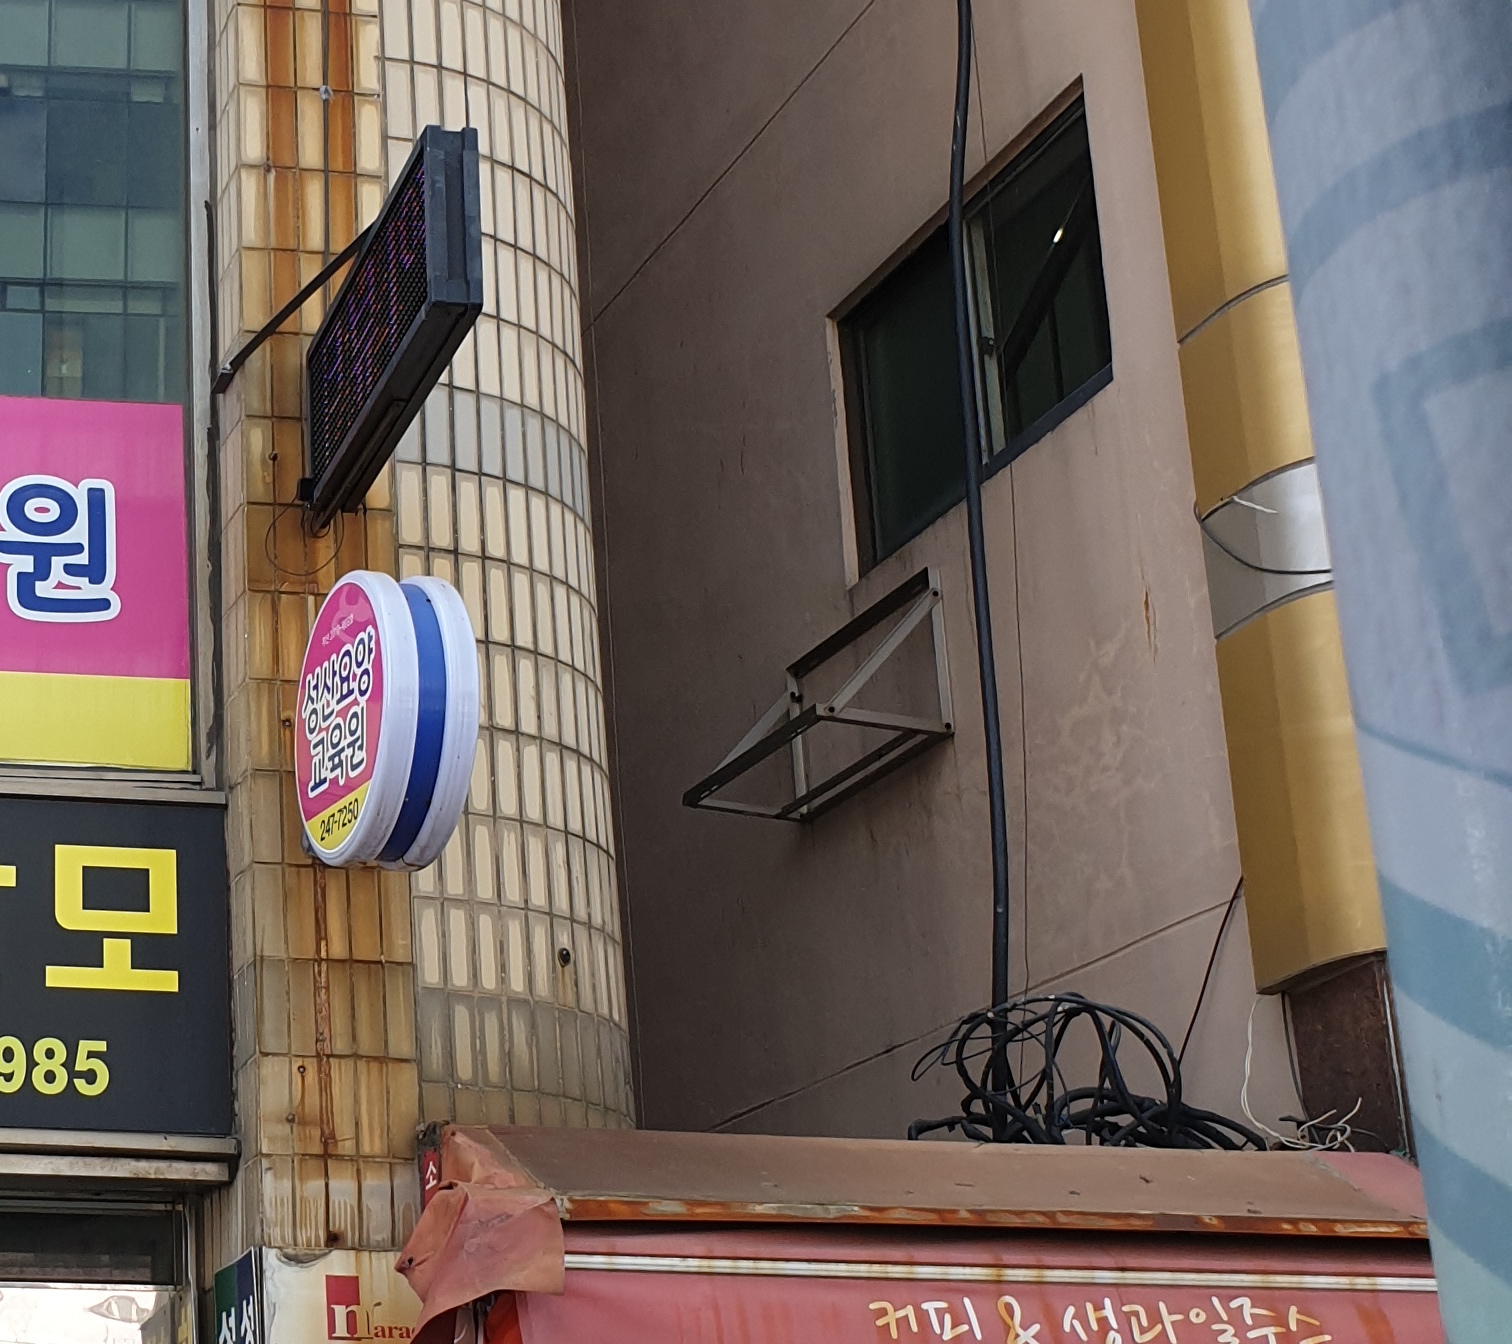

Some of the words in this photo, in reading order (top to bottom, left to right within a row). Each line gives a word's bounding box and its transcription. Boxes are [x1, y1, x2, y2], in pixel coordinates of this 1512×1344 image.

[302, 625, 376, 740] 성산요양
[307, 702, 367, 799] 교육원
[320, 797, 360, 842] 247-7250
[869, 1295, 983, 1342] 커피
